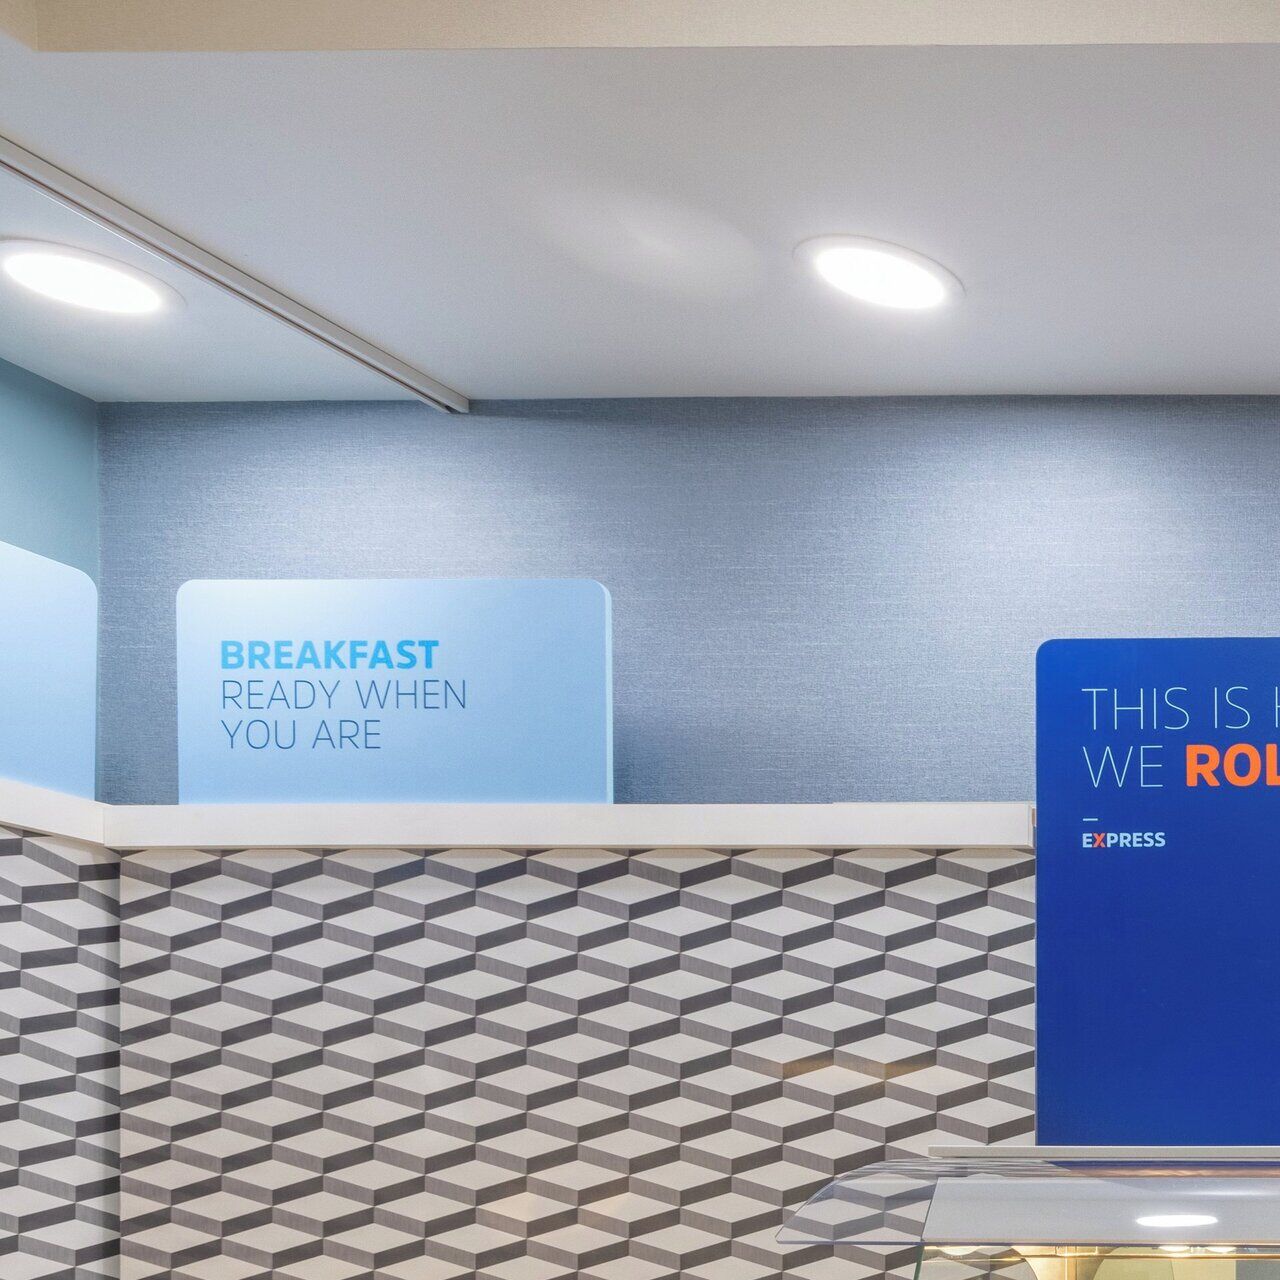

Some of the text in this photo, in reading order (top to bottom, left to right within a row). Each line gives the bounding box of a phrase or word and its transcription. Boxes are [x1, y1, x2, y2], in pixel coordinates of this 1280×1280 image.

[220, 640, 440, 669] BREAKFAST
[221, 679, 467, 710] READY WHEN
[1081, 686, 1191, 731] THIS
[1213, 685, 1251, 730] IS
[220, 719, 382, 750] YOU ARE
[1082, 745, 1164, 789] WE
[1082, 831, 1167, 849] EXPRESS
